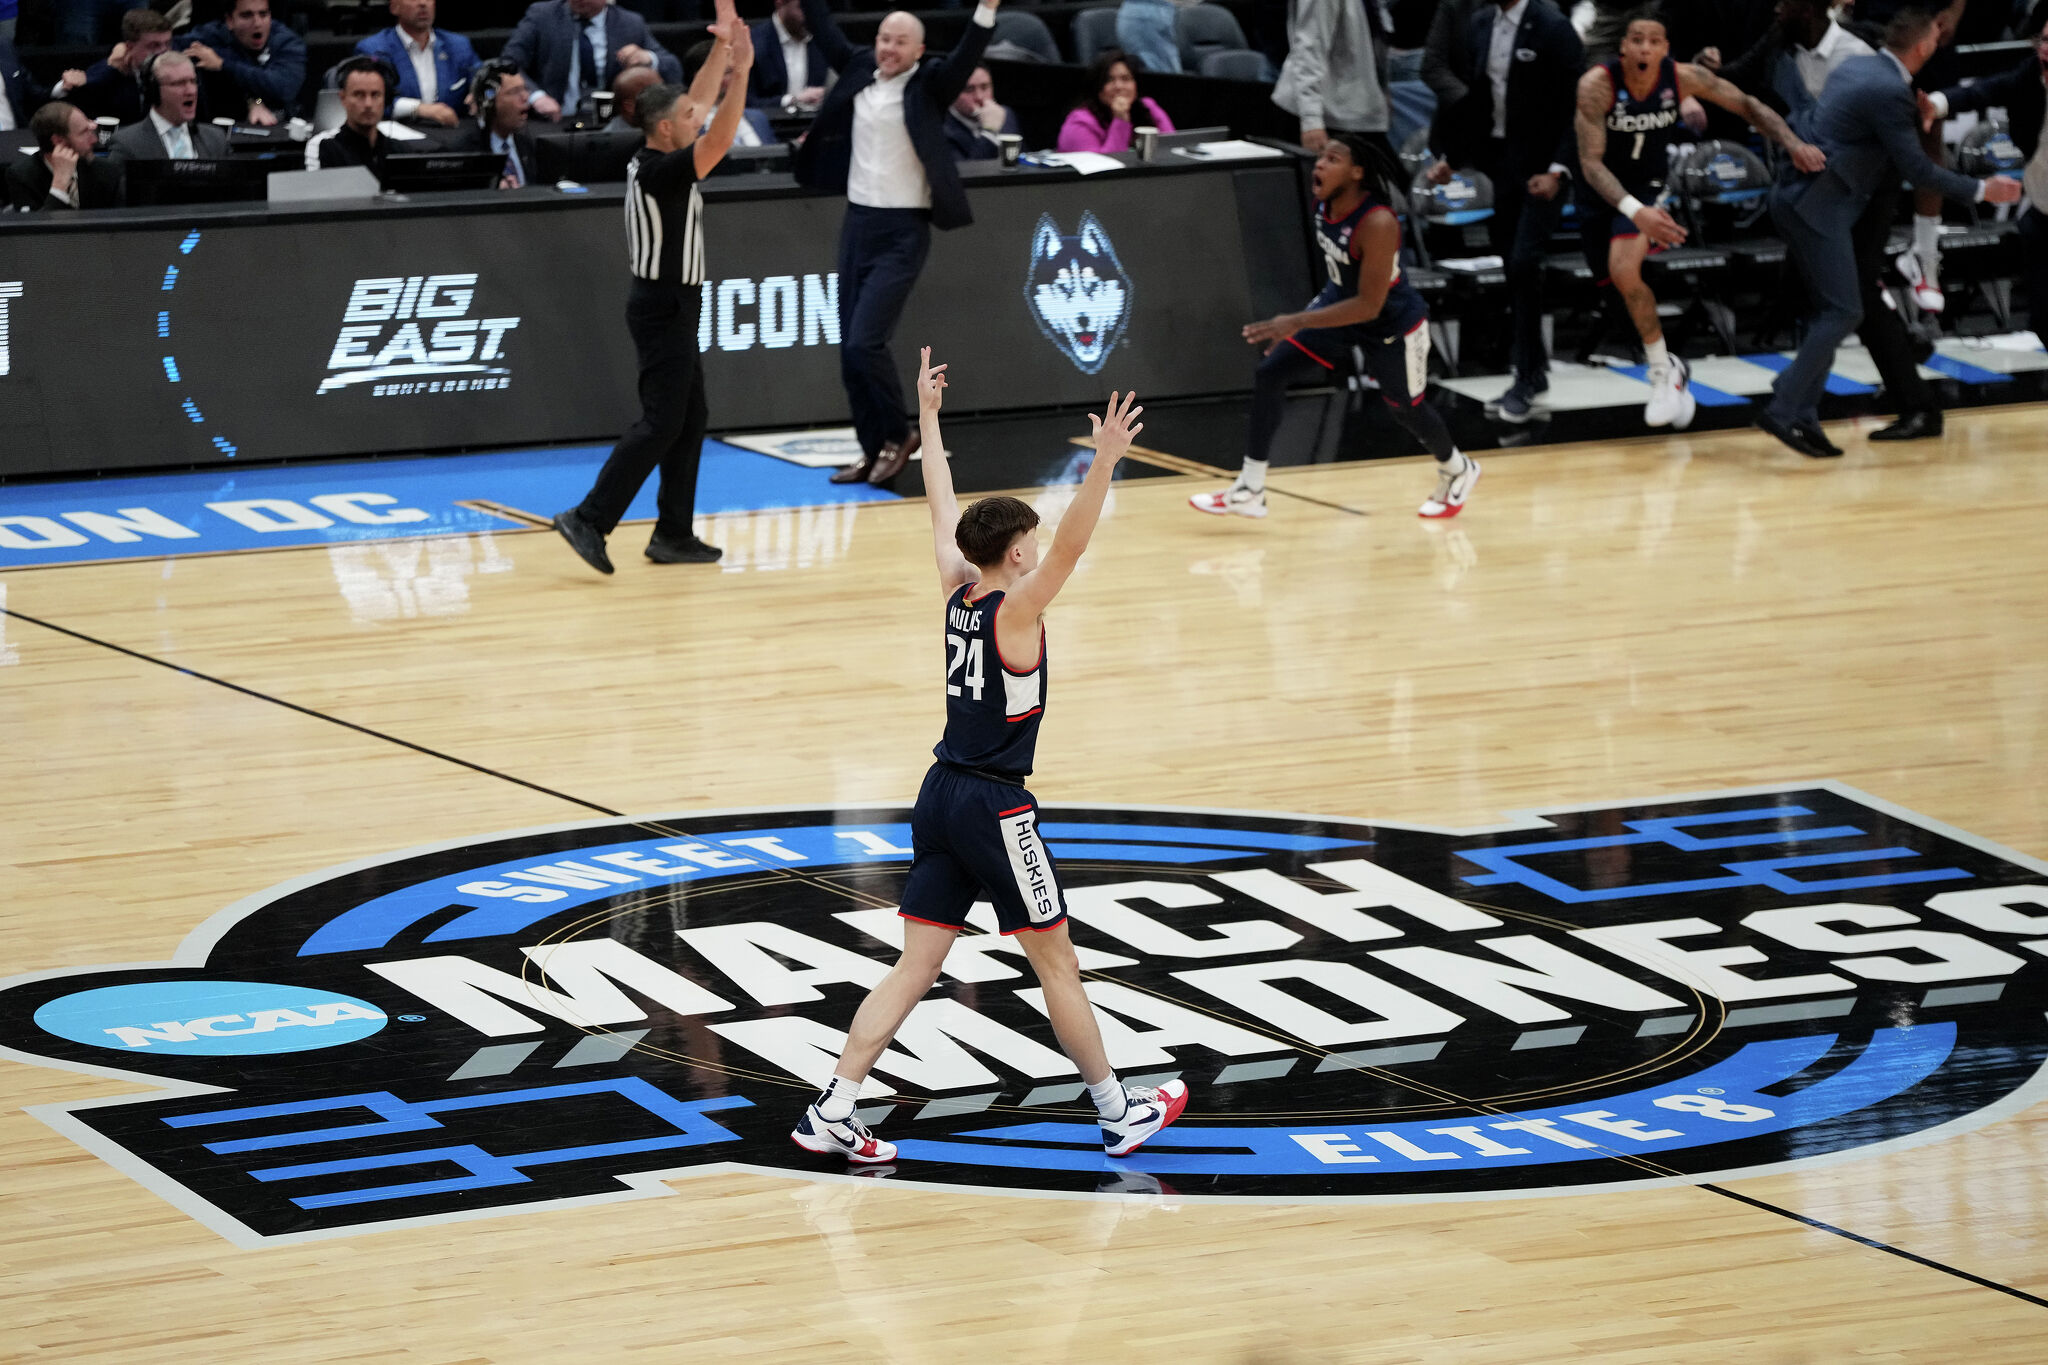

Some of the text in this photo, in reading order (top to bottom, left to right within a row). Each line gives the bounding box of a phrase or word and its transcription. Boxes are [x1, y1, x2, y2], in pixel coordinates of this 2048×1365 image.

[1631, 133, 1645, 159] 1
[342, 273, 478, 322] BIG
[697, 273, 842, 352] CON
[327, 317, 521, 369] EAST
[204, 492, 430, 533] DC
[947, 633, 985, 700] 24
[456, 831, 914, 903] SWEET 1
[1016, 820, 1052, 916] HUSKIES
[103, 1002, 388, 1048] NCAA
[1287, 1094, 1777, 1164] ELITE 8
